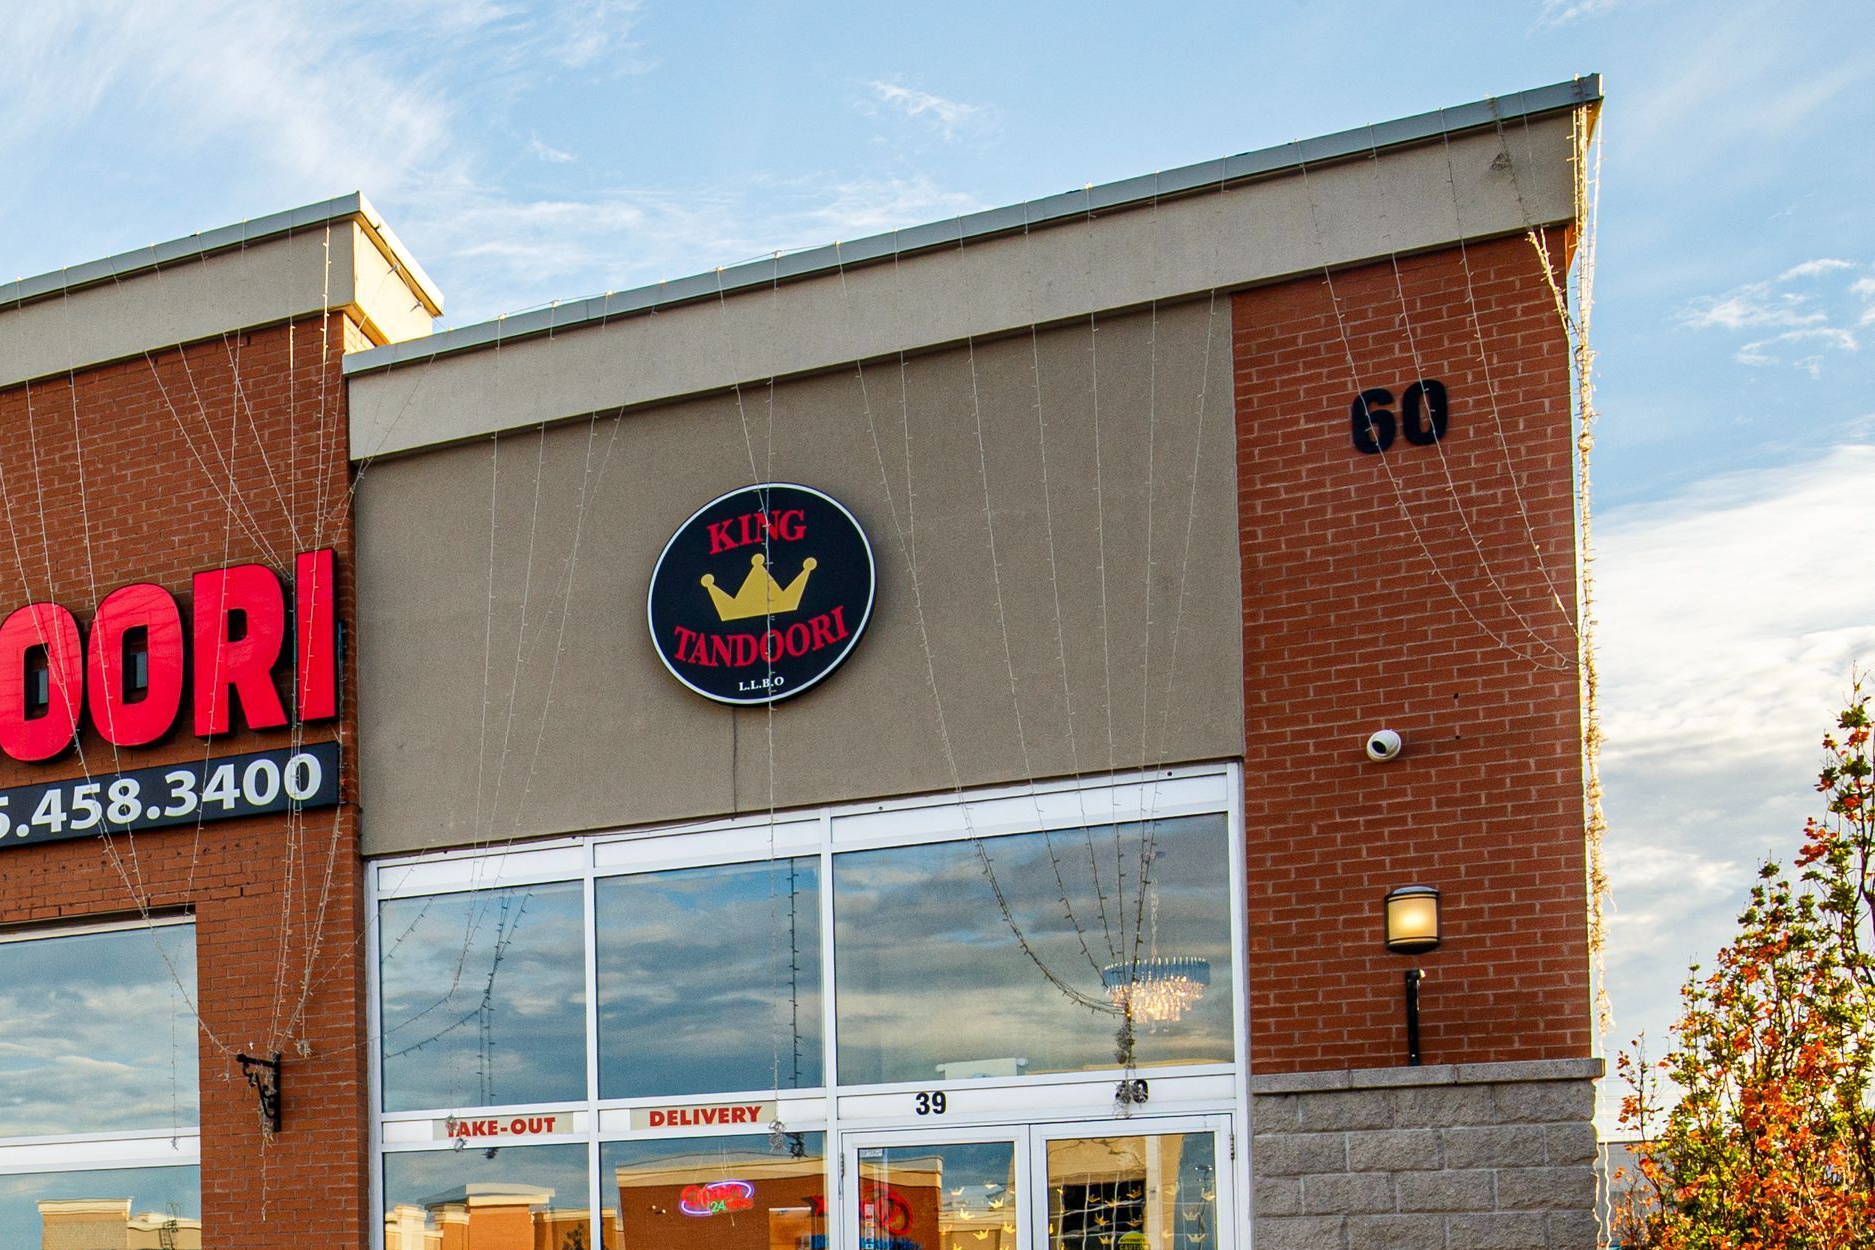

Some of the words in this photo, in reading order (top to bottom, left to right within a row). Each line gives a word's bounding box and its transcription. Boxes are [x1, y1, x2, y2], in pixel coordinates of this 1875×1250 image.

[1352, 379, 1448, 454] 60
[707, 509, 807, 555] KING
[674, 605, 850, 668] TANDOORI
[649, 1105, 762, 1127] DELIVERY
[915, 1091, 947, 1116] 39
